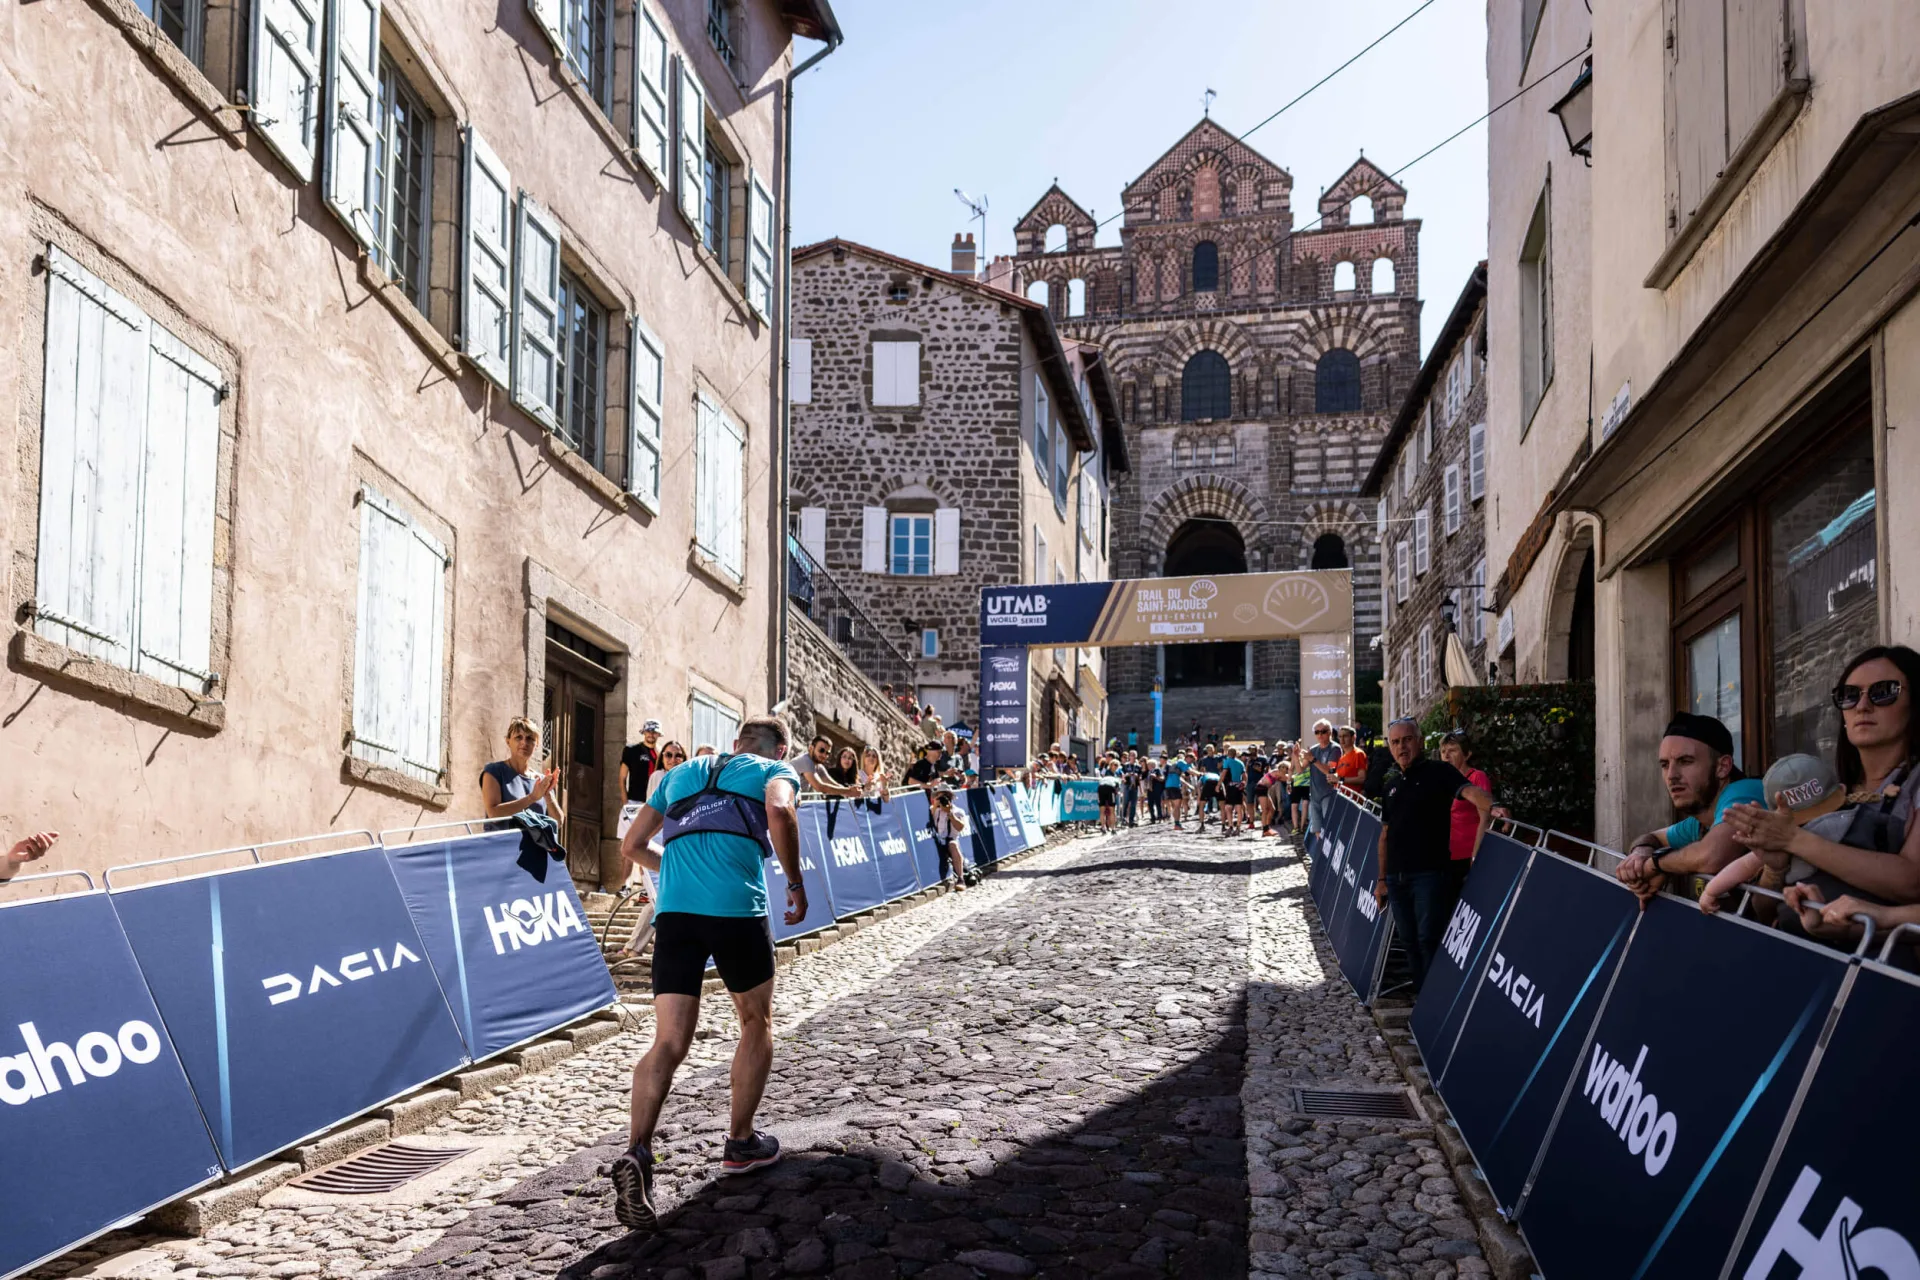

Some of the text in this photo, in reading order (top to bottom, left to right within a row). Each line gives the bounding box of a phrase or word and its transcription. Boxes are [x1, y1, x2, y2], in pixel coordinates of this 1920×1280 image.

[987, 594, 1047, 614] UTMB
[1137, 588, 1181, 601] TRAIL DU
[1137, 598, 1208, 613] SAINT-JACQUES
[989, 616, 1045, 624] WORLD SERIES
[1174, 624, 1198, 632] UTMB
[1312, 669, 1342, 680] HOKA
[989, 681, 1017, 691] HOKA
[986, 714, 1019, 724] wahoo
[1312, 704, 1346, 714] wahoo
[1783, 778, 1823, 806] NYC
[691, 799, 728, 818] RAIDLIGHT
[830, 836, 870, 868] HOKA
[879, 831, 907, 856] wahoo
[1356, 880, 1378, 923] wahoo
[483, 890, 586, 955] HOKA
[1442, 898, 1481, 970] HOKA
[261, 942, 421, 1006] DACIA
[1488, 951, 1544, 1029] DACIA
[0, 1020, 161, 1105] ahoo
[1583, 1042, 1677, 1177] wahoo
